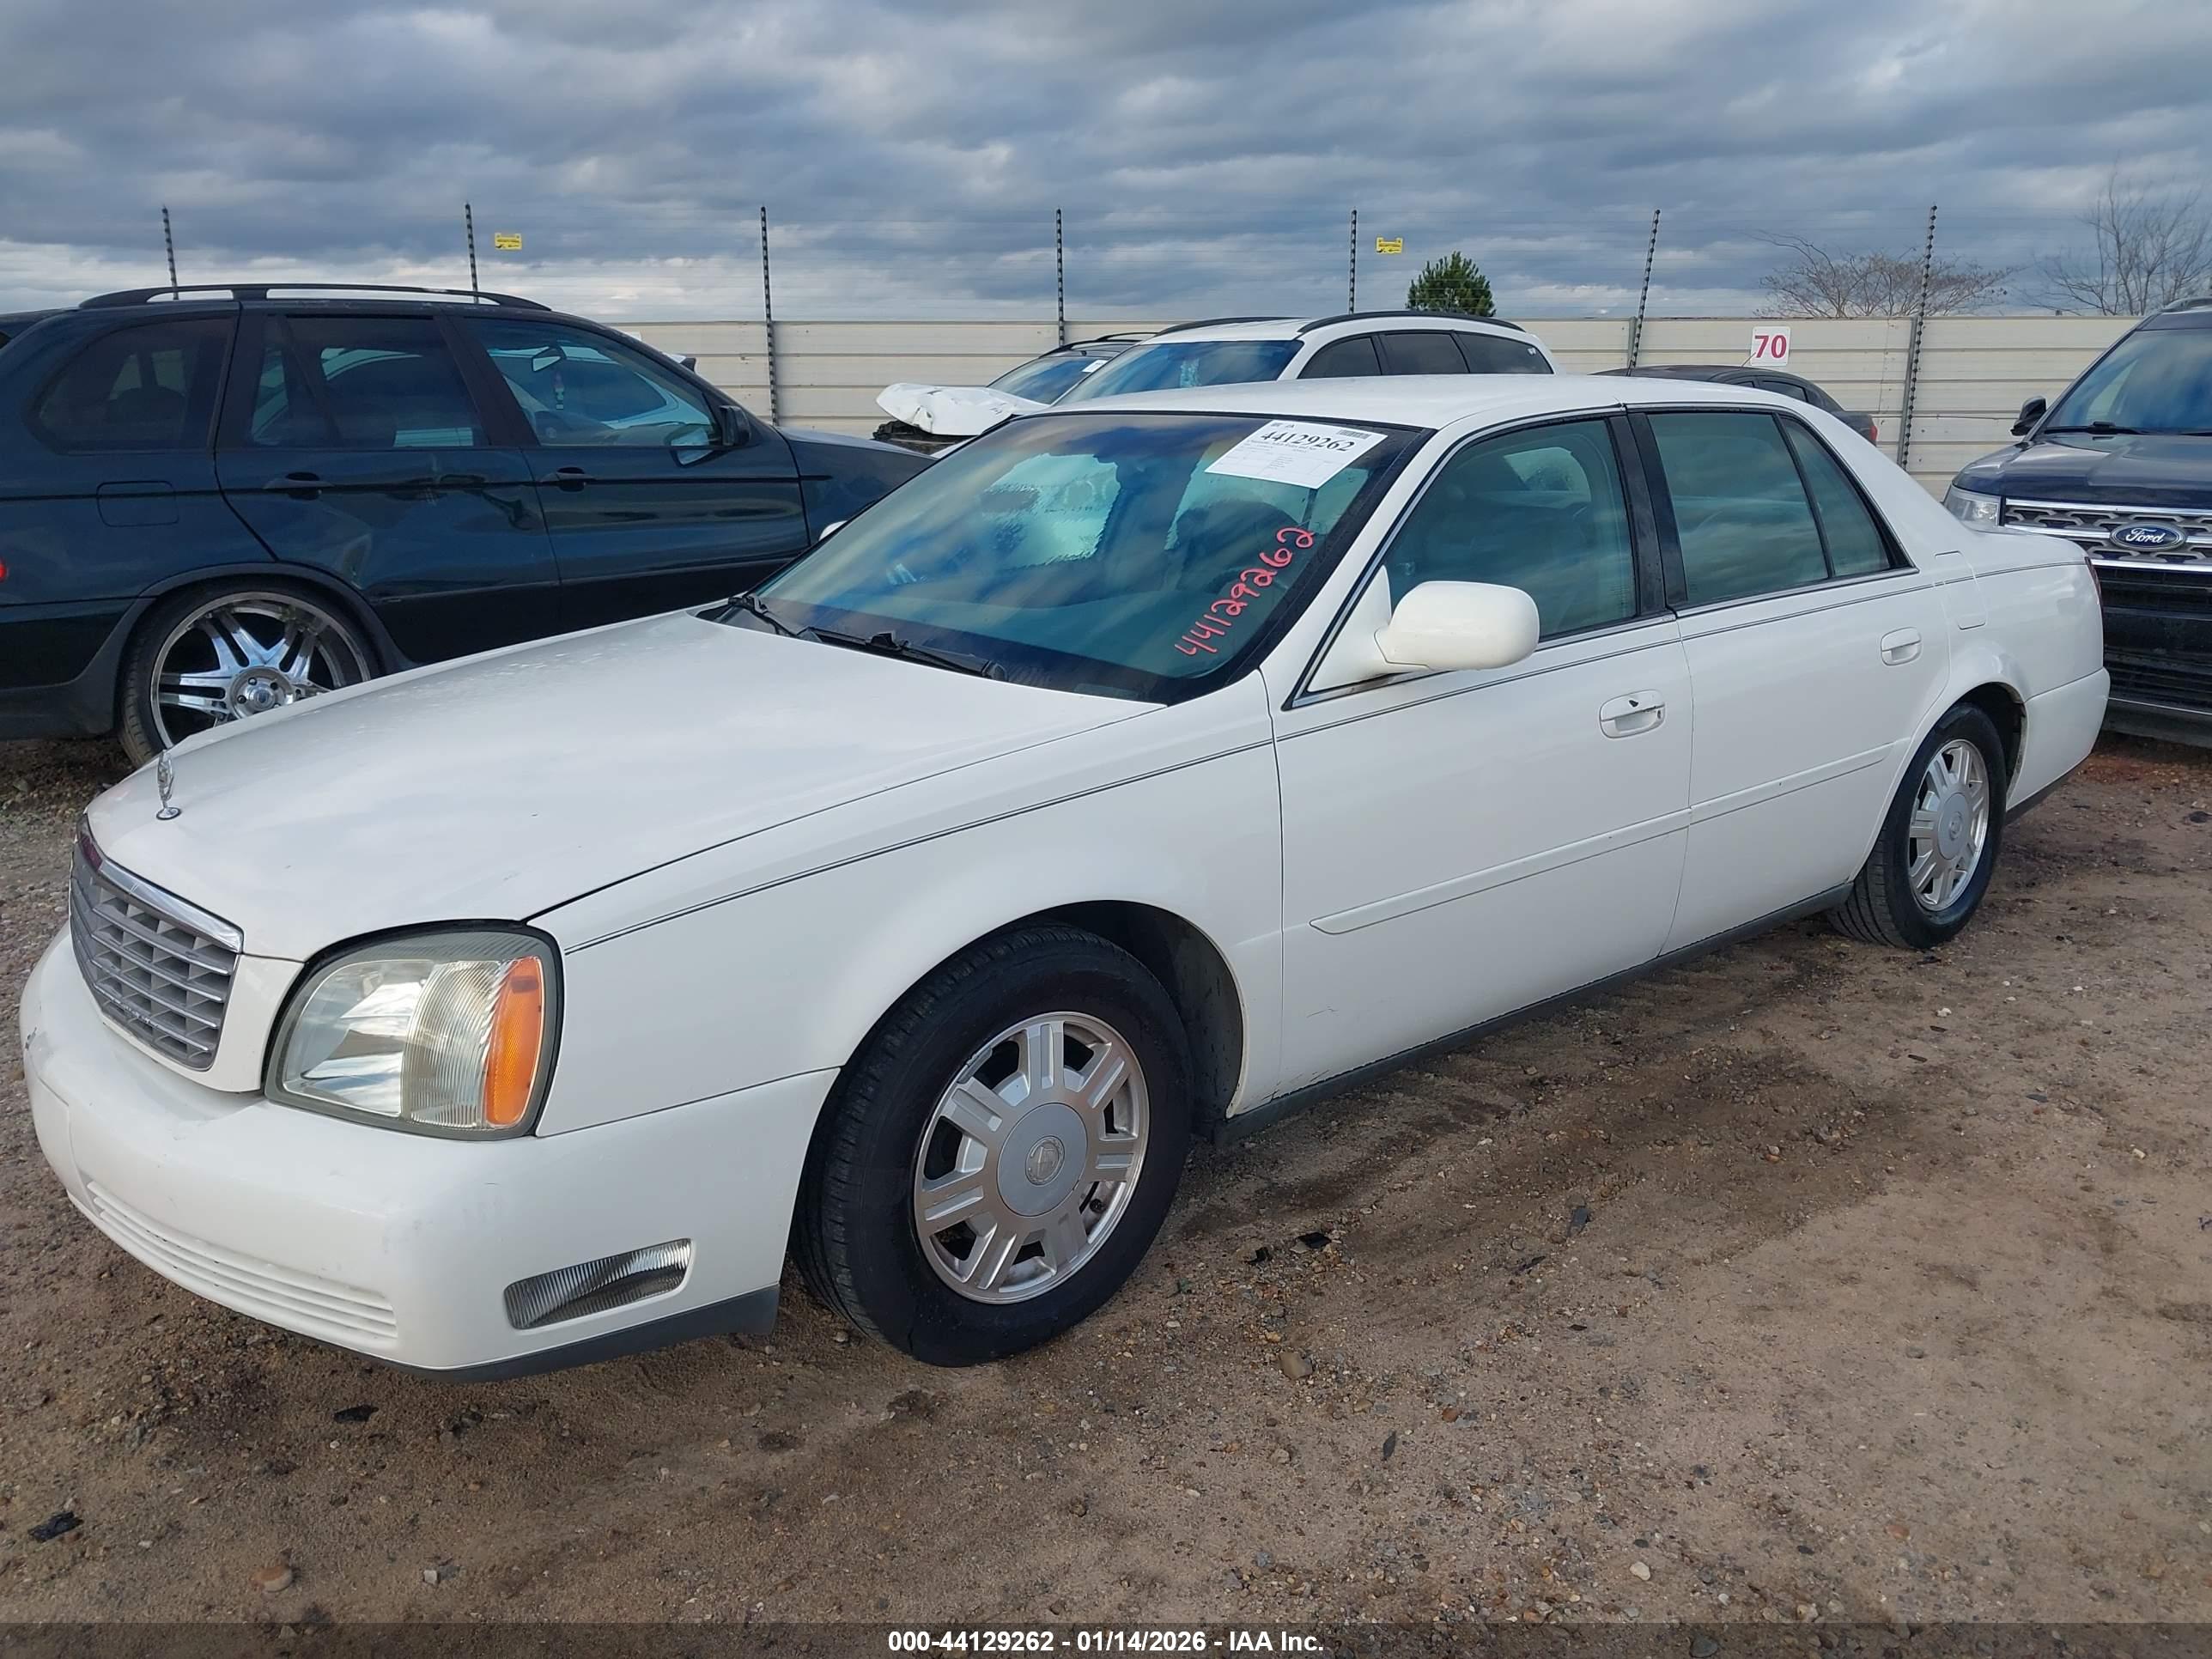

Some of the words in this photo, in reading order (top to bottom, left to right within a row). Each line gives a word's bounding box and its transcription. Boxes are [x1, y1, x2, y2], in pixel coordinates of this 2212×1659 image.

[1754, 334, 1787, 358] 70
[1260, 430, 1356, 453] 44129262
[2125, 527, 2166, 544] Ford
[1174, 526, 1316, 656] 44129262
